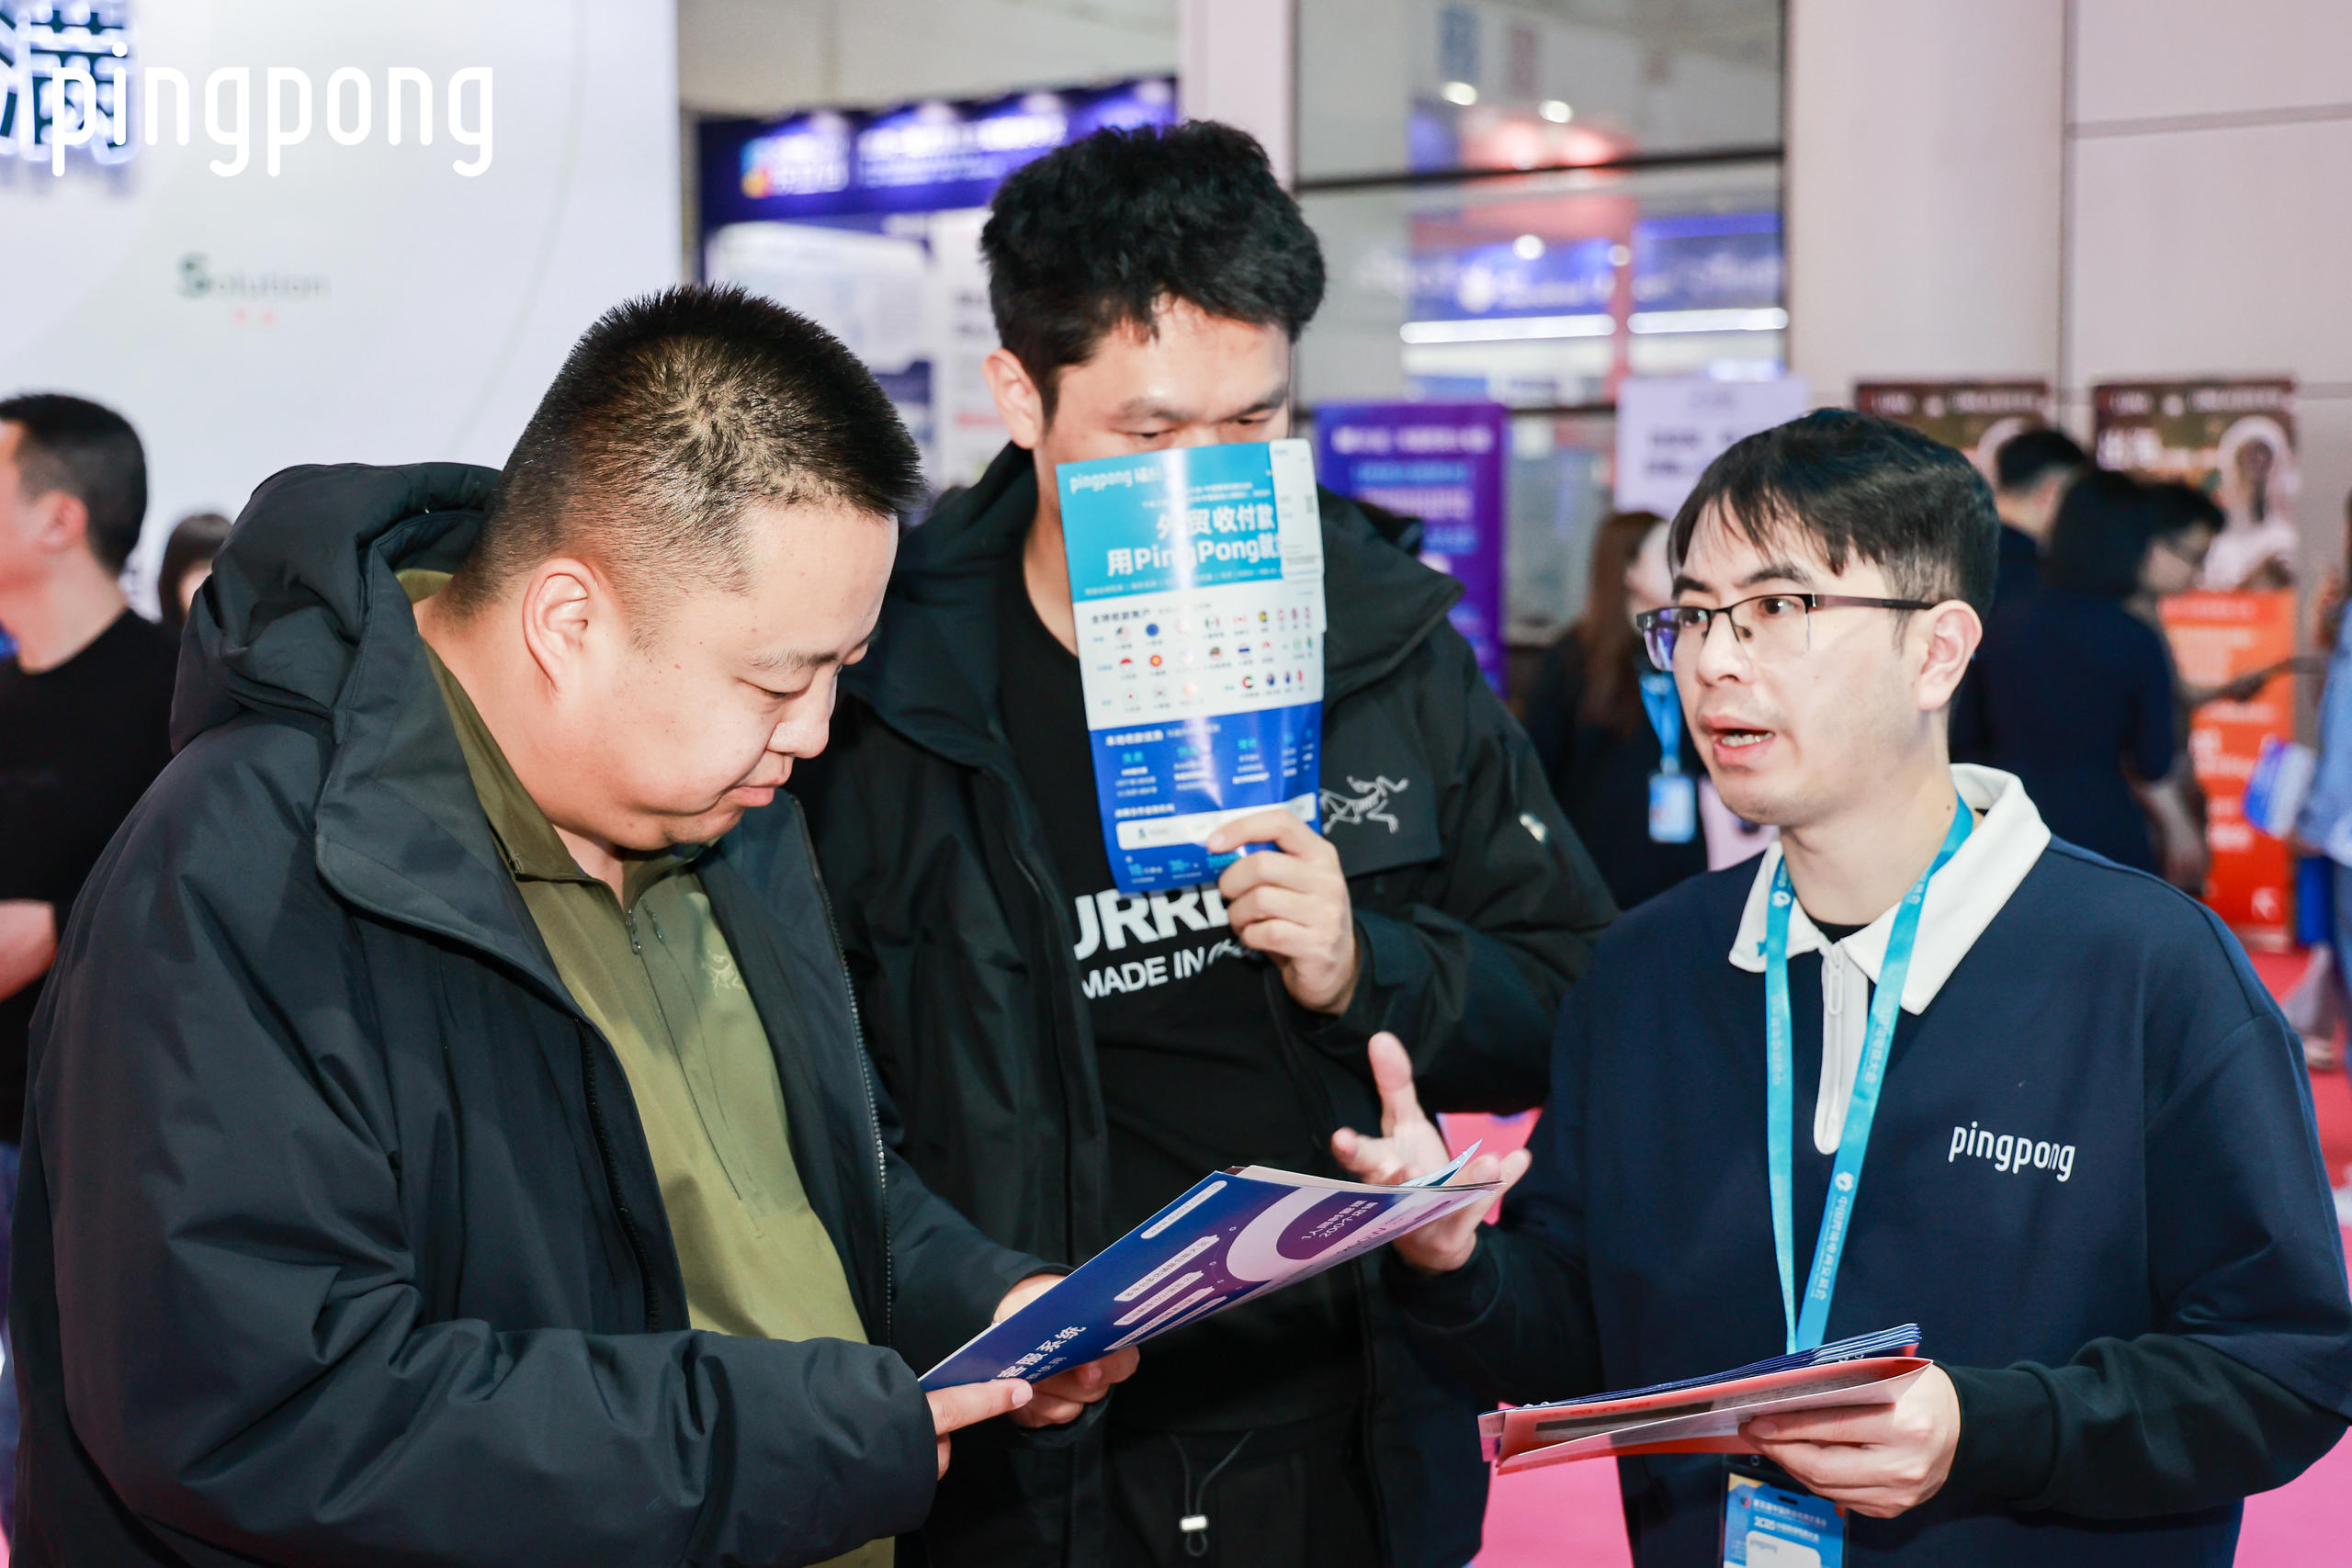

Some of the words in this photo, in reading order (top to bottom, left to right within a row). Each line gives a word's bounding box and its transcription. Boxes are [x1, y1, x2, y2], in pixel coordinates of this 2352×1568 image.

[1173, 945, 1205, 979] IN
[1948, 1121, 2076, 1183] pingpong
[989, 1326, 1087, 1382] 客服系统
